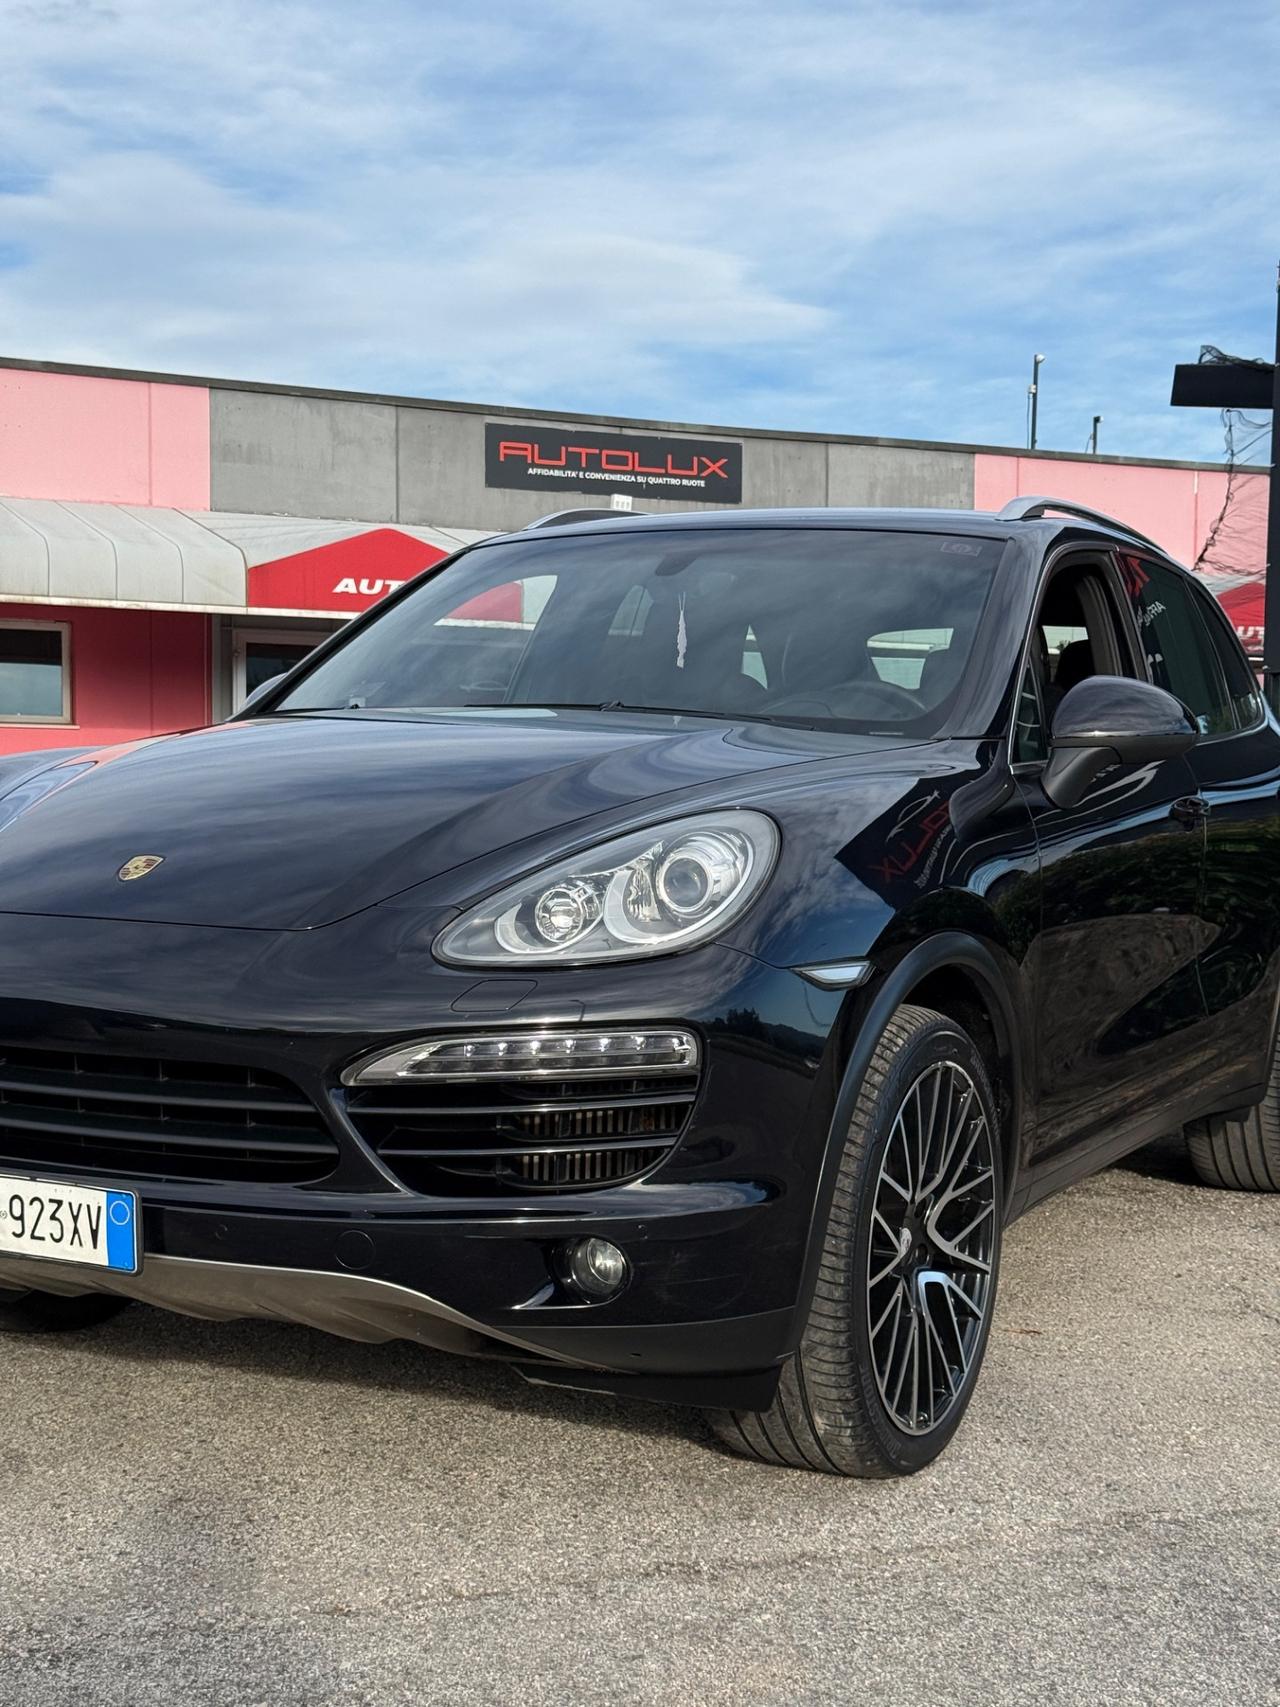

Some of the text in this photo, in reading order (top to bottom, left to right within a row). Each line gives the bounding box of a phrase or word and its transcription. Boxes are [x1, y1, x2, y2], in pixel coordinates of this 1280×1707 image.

[499, 441, 729, 479] AUTOLUX
[527, 467, 706, 488] AFFIDABILITA' E CONVENIENZA SU QUATTRO RUOTE
[331, 577, 406, 595] AUT
[1236, 625, 1265, 639] UT
[8, 1193, 102, 1250] 923XV
